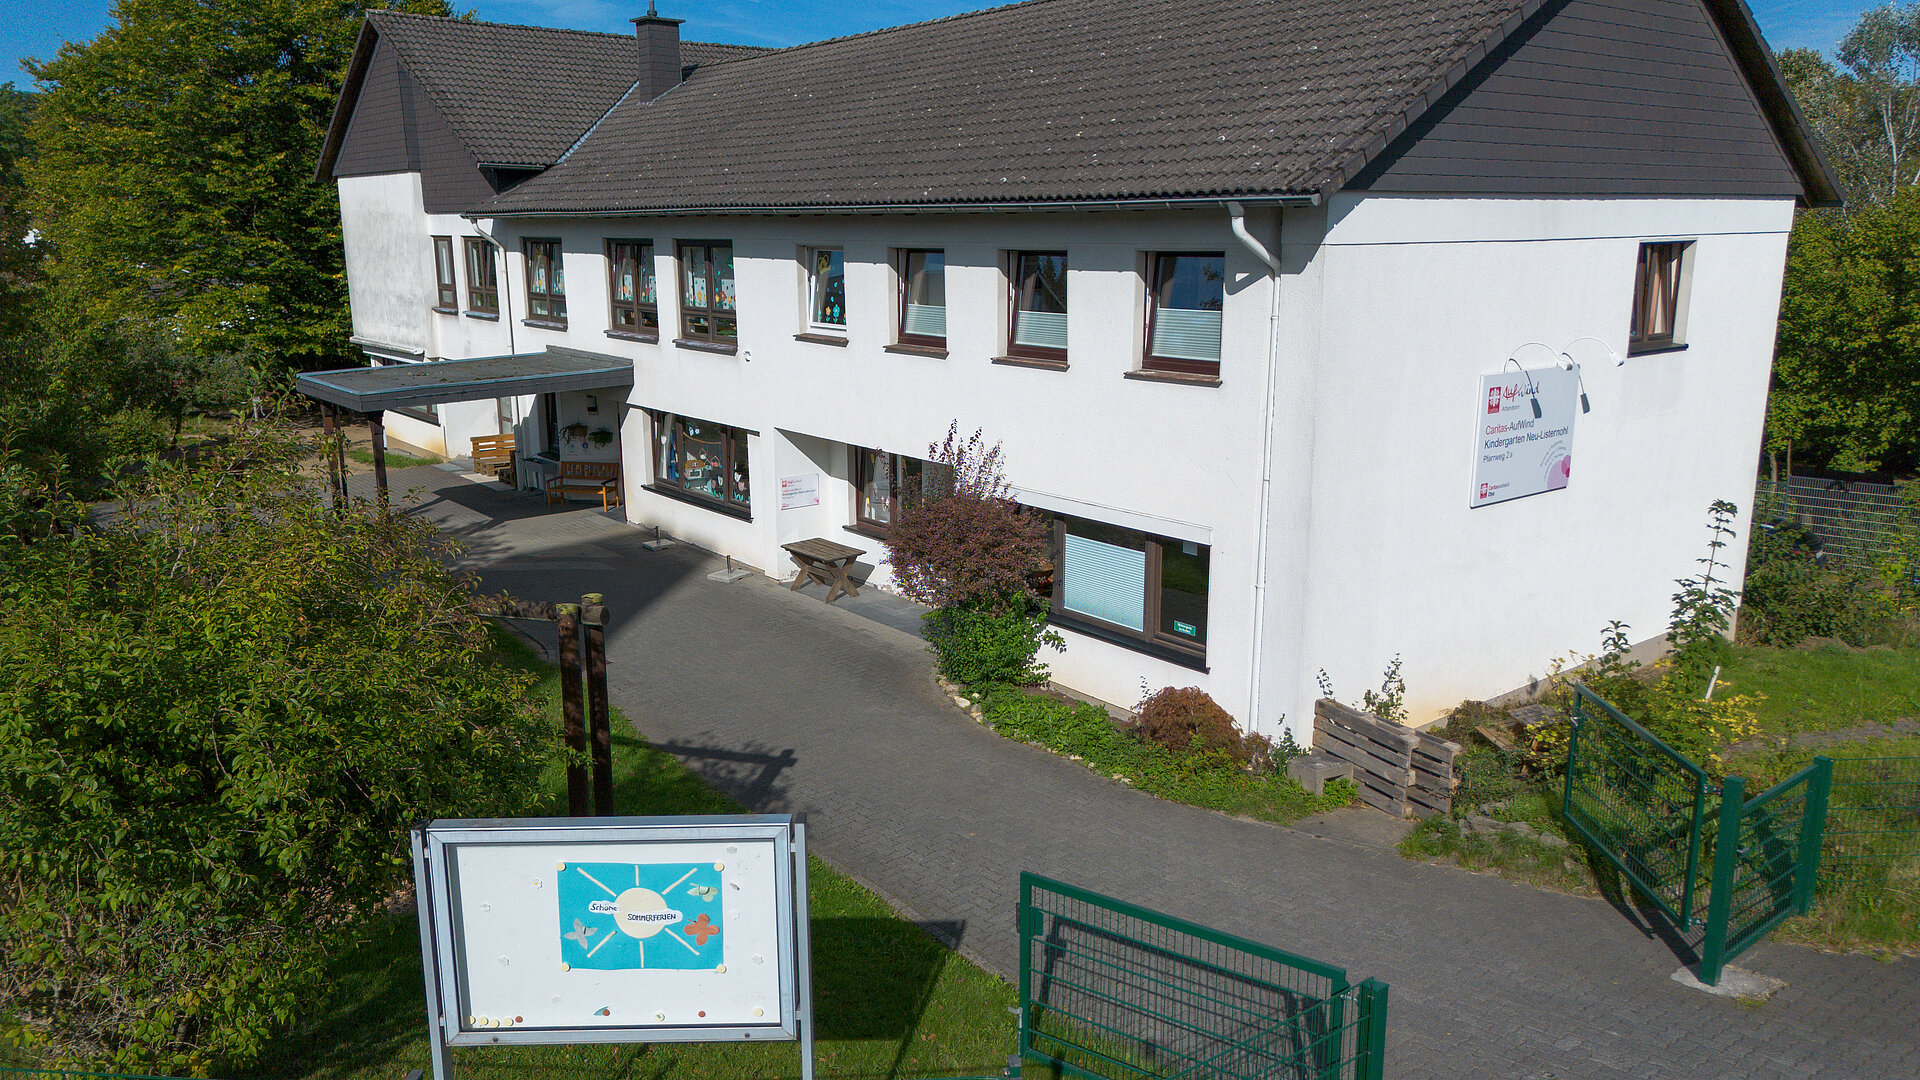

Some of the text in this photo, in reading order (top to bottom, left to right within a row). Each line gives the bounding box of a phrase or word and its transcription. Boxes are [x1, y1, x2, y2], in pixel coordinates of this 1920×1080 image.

[1485, 419, 1534, 436] Caritas-AufWind
[1484, 426, 1569, 449] Kindergarten Neu-Listernohl
[590, 903, 618, 912] Schöne
[627, 913, 677, 922] SOMMERFERIEN
